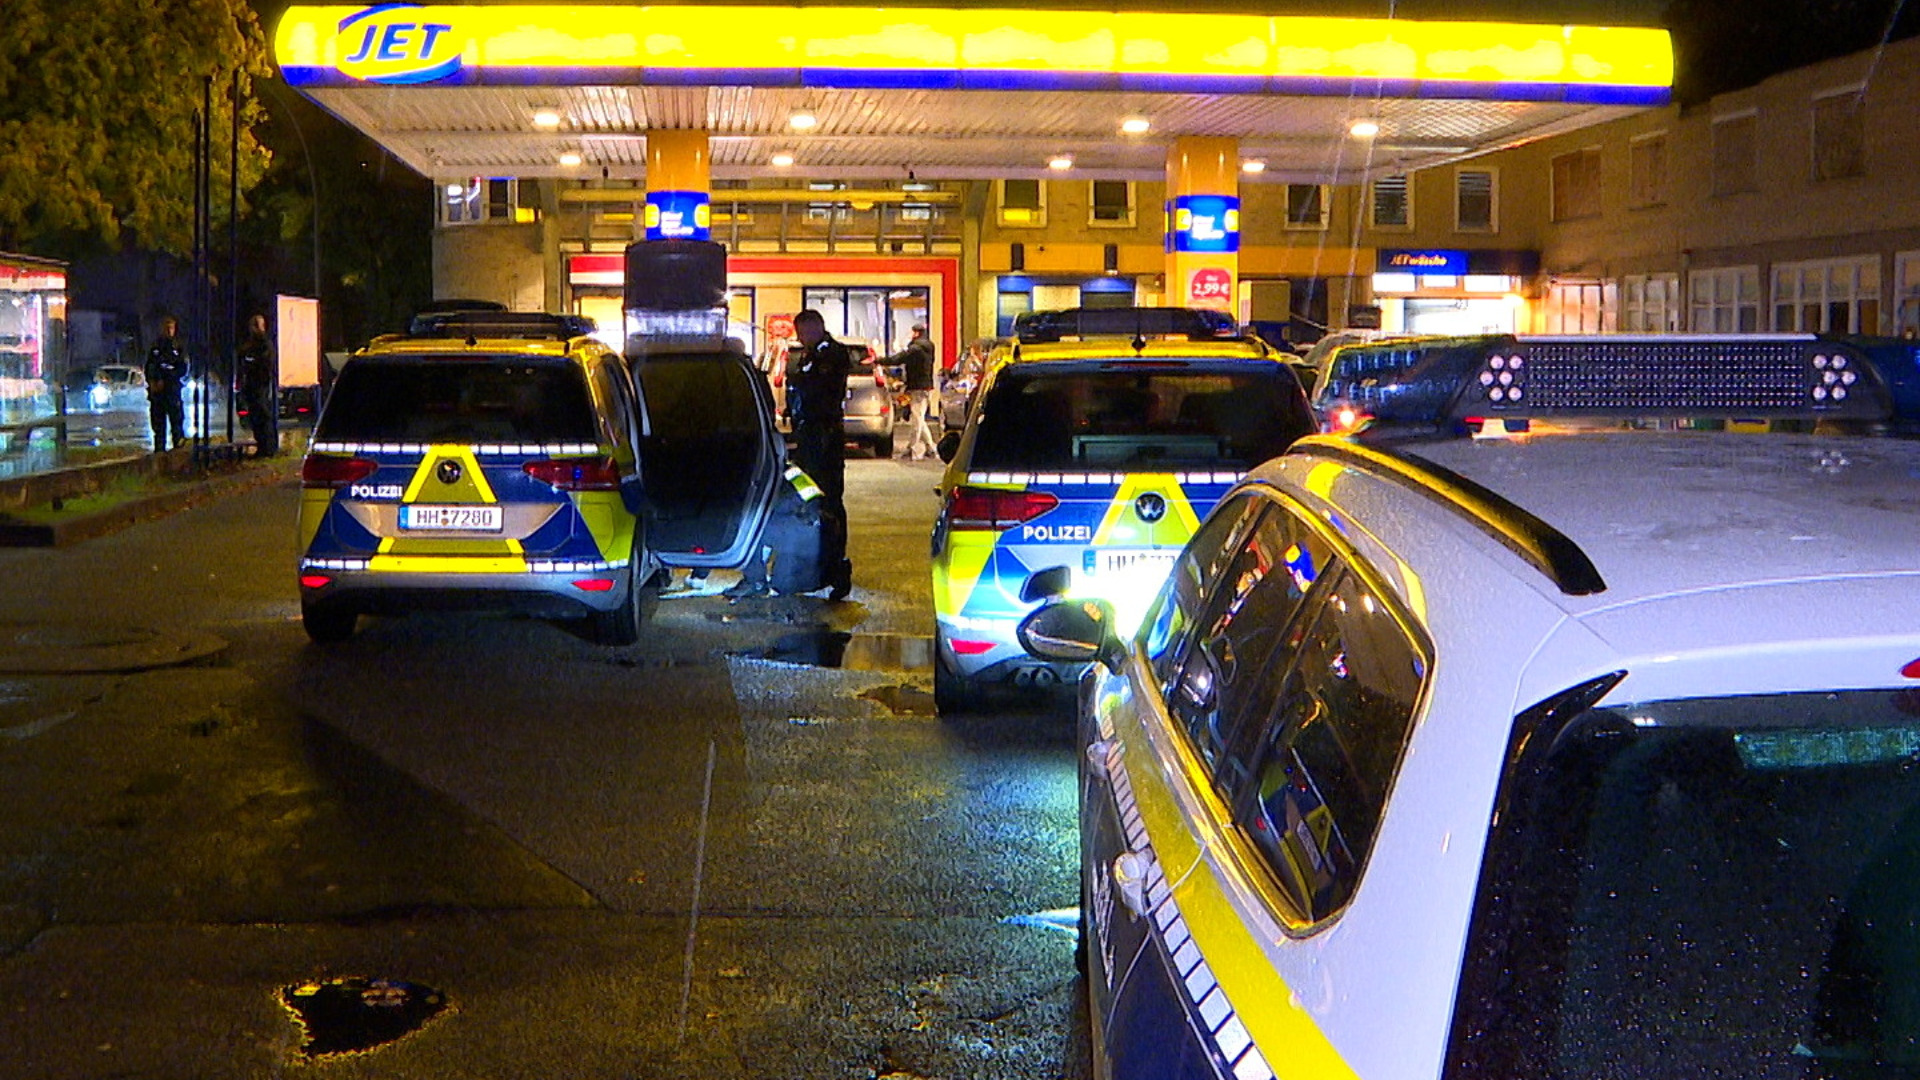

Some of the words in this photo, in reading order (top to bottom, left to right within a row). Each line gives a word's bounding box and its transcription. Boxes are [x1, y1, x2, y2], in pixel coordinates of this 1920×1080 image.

[346, 23, 452, 62] JET
[351, 485, 403, 498] POLIZEI
[416, 510, 439, 525] HH
[451, 510, 493, 527] 7280
[1023, 525, 1091, 540] POLIZEI
